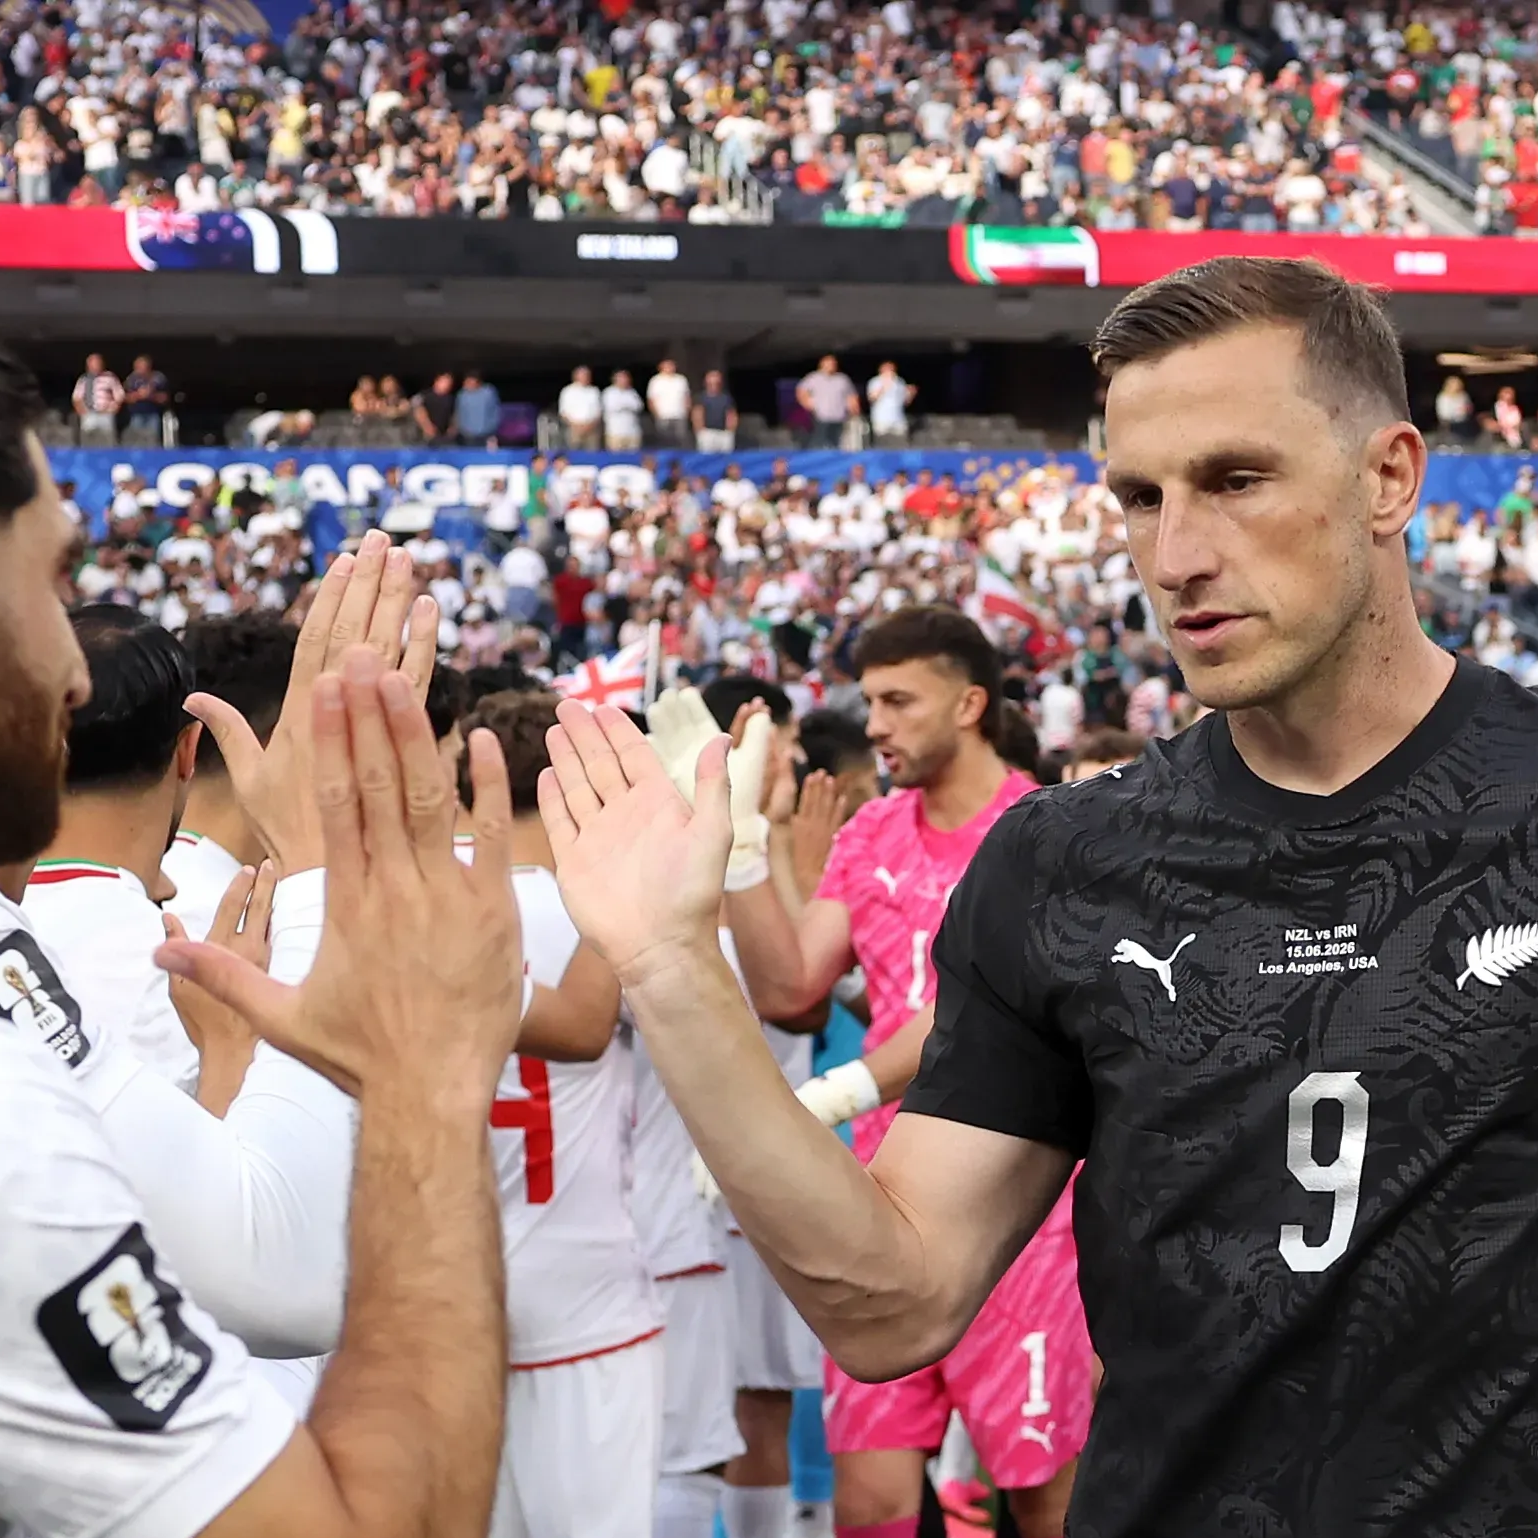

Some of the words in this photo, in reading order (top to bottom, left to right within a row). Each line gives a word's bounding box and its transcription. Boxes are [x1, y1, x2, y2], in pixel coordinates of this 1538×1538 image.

[1284, 928, 1313, 942] NZL
[1315, 929, 1331, 940] vs
[1333, 923, 1358, 939] IRN
[1285, 941, 1356, 958] 15.06.2026
[1258, 962, 1284, 974] Los
[1285, 960, 1345, 975] Angeles,
[1348, 956, 1379, 970] USA
[1279, 1071, 1370, 1273] 9
[1020, 1331, 1050, 1418] 1
